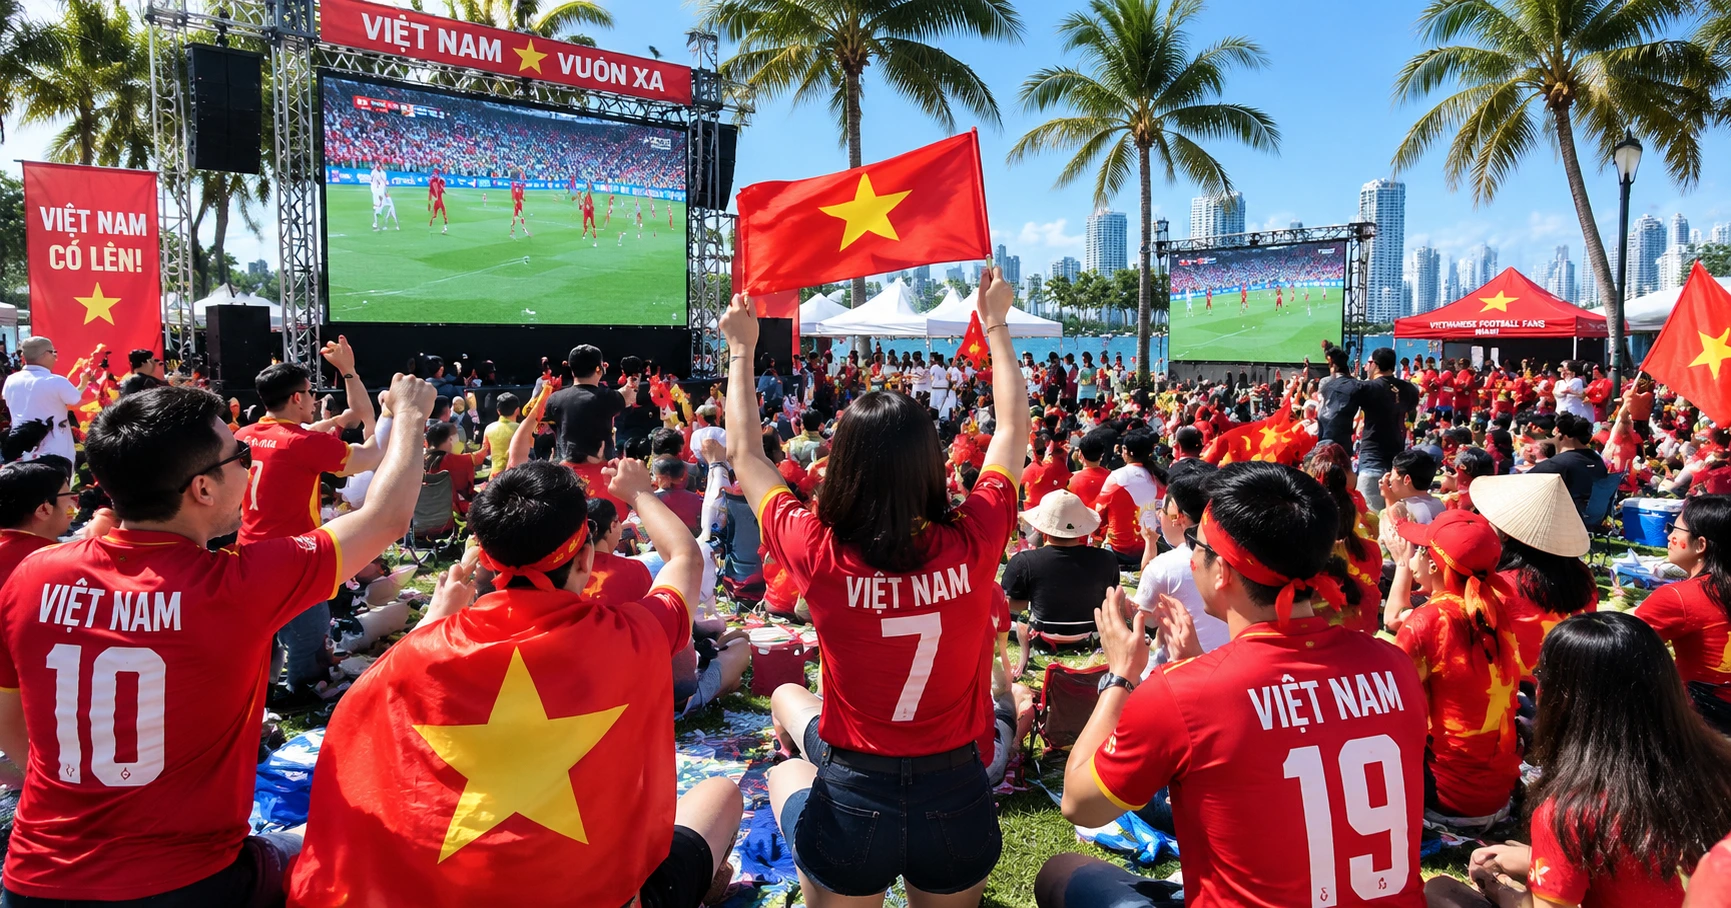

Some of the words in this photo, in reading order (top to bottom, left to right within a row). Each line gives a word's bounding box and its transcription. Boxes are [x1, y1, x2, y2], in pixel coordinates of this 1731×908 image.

[361, 12, 430, 53] VIỆT
[438, 28, 502, 63] NAM
[632, 66, 665, 92] XA
[39, 202, 91, 238] VIỆT
[97, 210, 147, 236] NAM
[38, 577, 105, 633] VIỆT
[109, 590, 182, 632] NAM
[846, 571, 902, 614] VIỆT
[910, 563, 971, 607] NAM
[881, 612, 942, 722] 7
[46, 643, 166, 787] 10
[1247, 674, 1324, 733] VIỆT
[1328, 671, 1405, 720] NAM
[1282, 733, 1410, 908] 19
